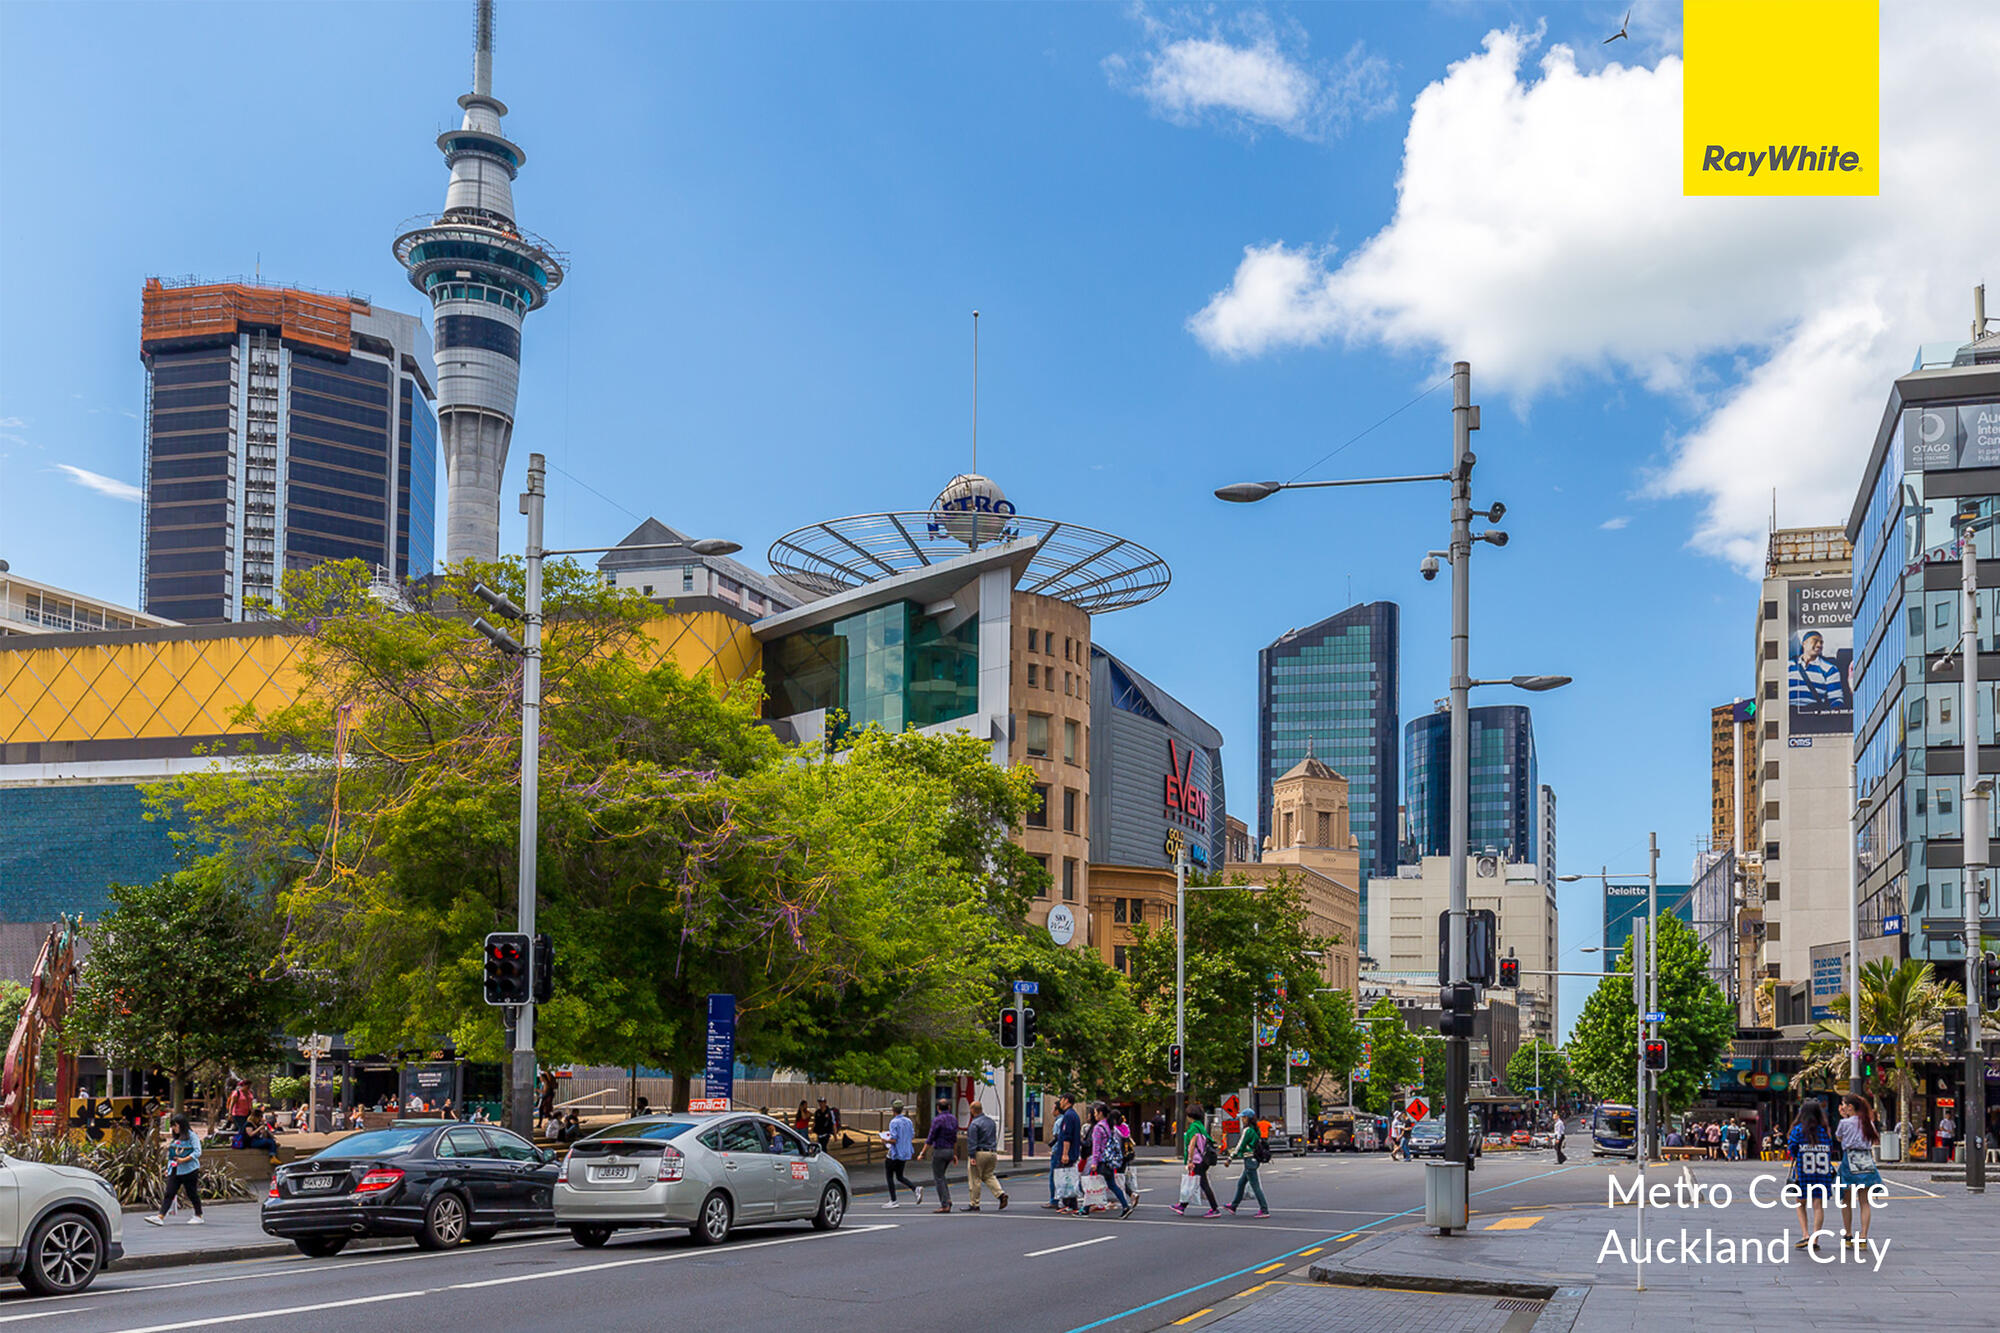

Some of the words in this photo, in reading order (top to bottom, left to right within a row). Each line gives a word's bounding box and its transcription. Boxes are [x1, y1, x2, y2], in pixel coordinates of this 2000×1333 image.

[1912, 443, 1951, 454] OTAGO
[929, 495, 1016, 520] ETRO
[1802, 602, 1809, 612] a
[1812, 601, 1839, 611] new
[1801, 614, 1815, 624] to
[1818, 613, 1852, 623] move
[1165, 738, 1209, 823] EVENT
[1477, 857, 1497, 878] G
[1608, 886, 1647, 895] Deloitte
[1884, 919, 1899, 931] APN
[1802, 1152, 1829, 1174] 89
